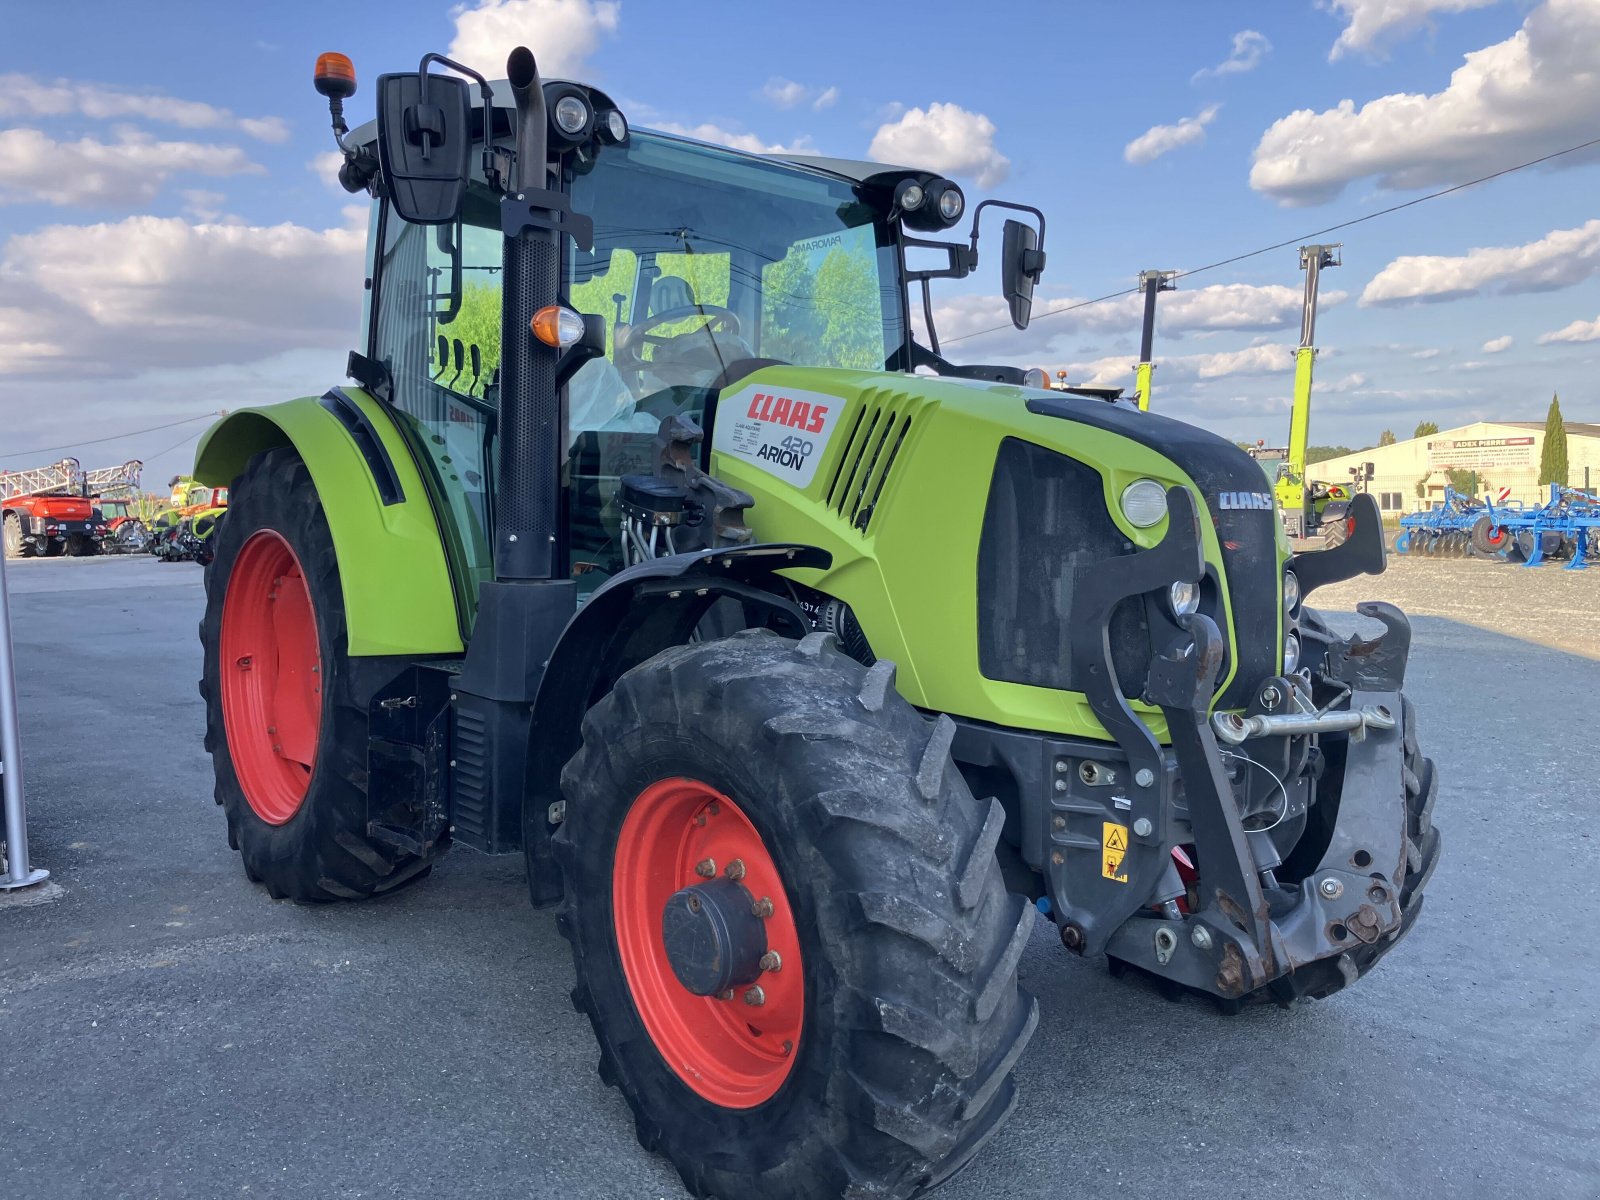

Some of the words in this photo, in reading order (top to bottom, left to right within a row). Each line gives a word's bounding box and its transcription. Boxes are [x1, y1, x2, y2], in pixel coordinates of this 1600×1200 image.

[746, 393, 829, 434] CLAAS
[781, 435, 814, 457] 420
[1478, 439, 1506, 447] PIERRE
[756, 443, 805, 471] ARION
[1219, 492, 1273, 510] CLAAS
